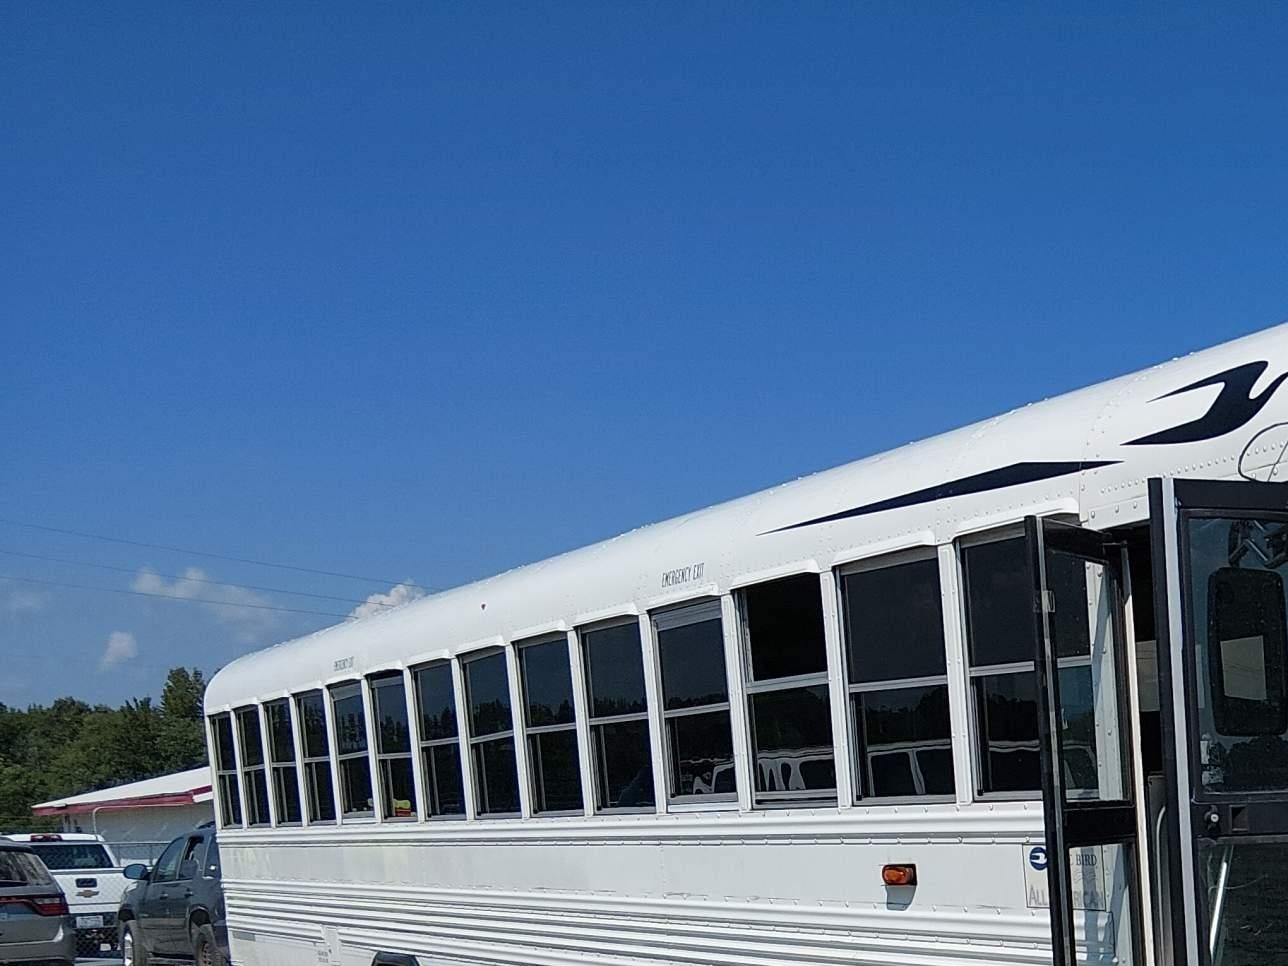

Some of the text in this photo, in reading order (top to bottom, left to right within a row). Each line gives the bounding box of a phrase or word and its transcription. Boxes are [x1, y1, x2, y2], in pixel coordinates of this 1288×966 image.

[662, 562, 704, 588] EMERGENCY EXIT
[1076, 854, 1097, 866] BIRD
[1029, 885, 1049, 906] ALL
